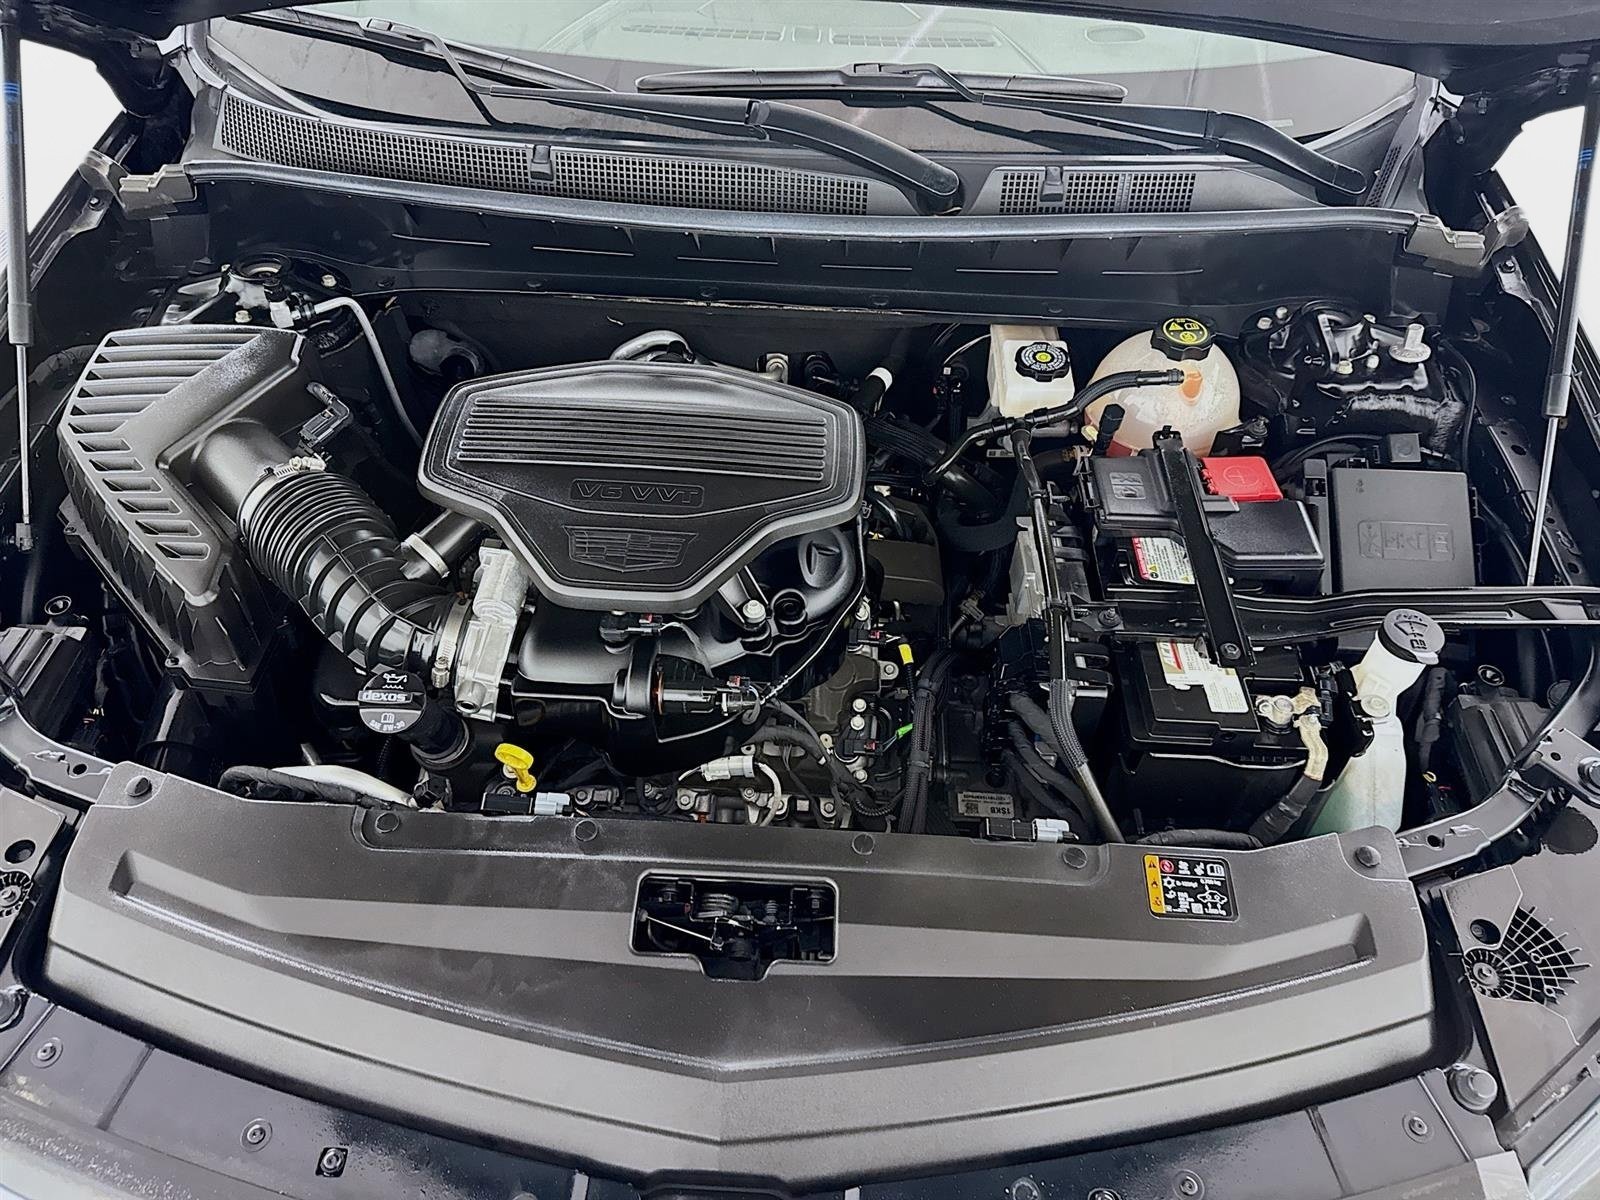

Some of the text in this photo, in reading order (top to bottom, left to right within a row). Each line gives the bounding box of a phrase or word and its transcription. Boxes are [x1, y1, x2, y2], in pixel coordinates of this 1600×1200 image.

[576, 482, 699, 503] V6 VVT
[362, 689, 408, 702] dexos
